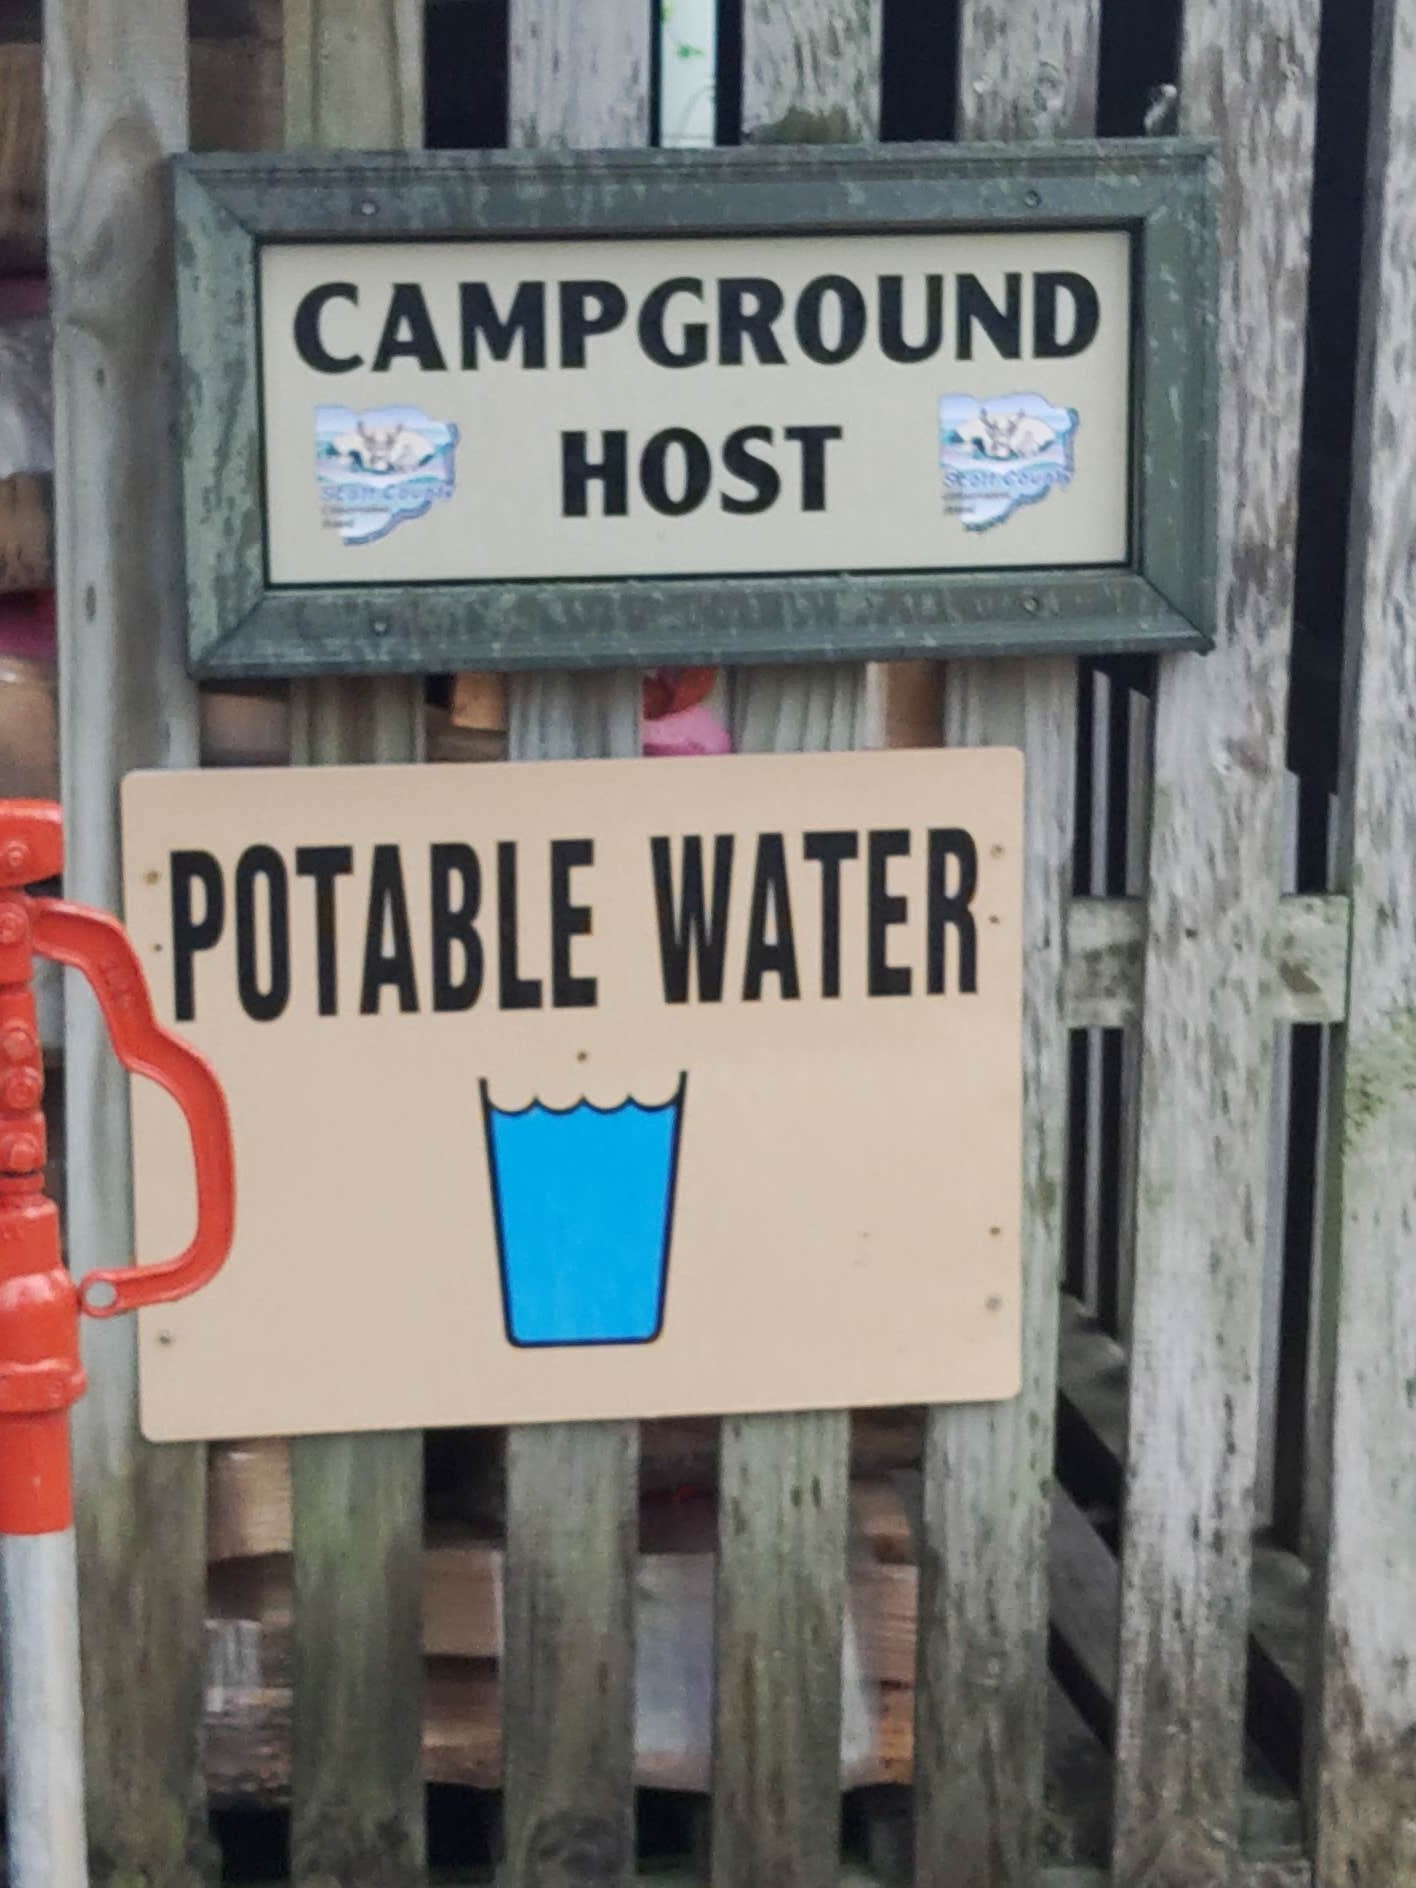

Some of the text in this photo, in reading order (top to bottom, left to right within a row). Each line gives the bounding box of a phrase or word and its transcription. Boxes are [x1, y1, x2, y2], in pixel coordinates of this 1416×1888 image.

[293, 271, 1100, 374] CAMPGROUND
[561, 425, 843, 518] HOST
[170, 827, 978, 1023] POTABLE WATER
